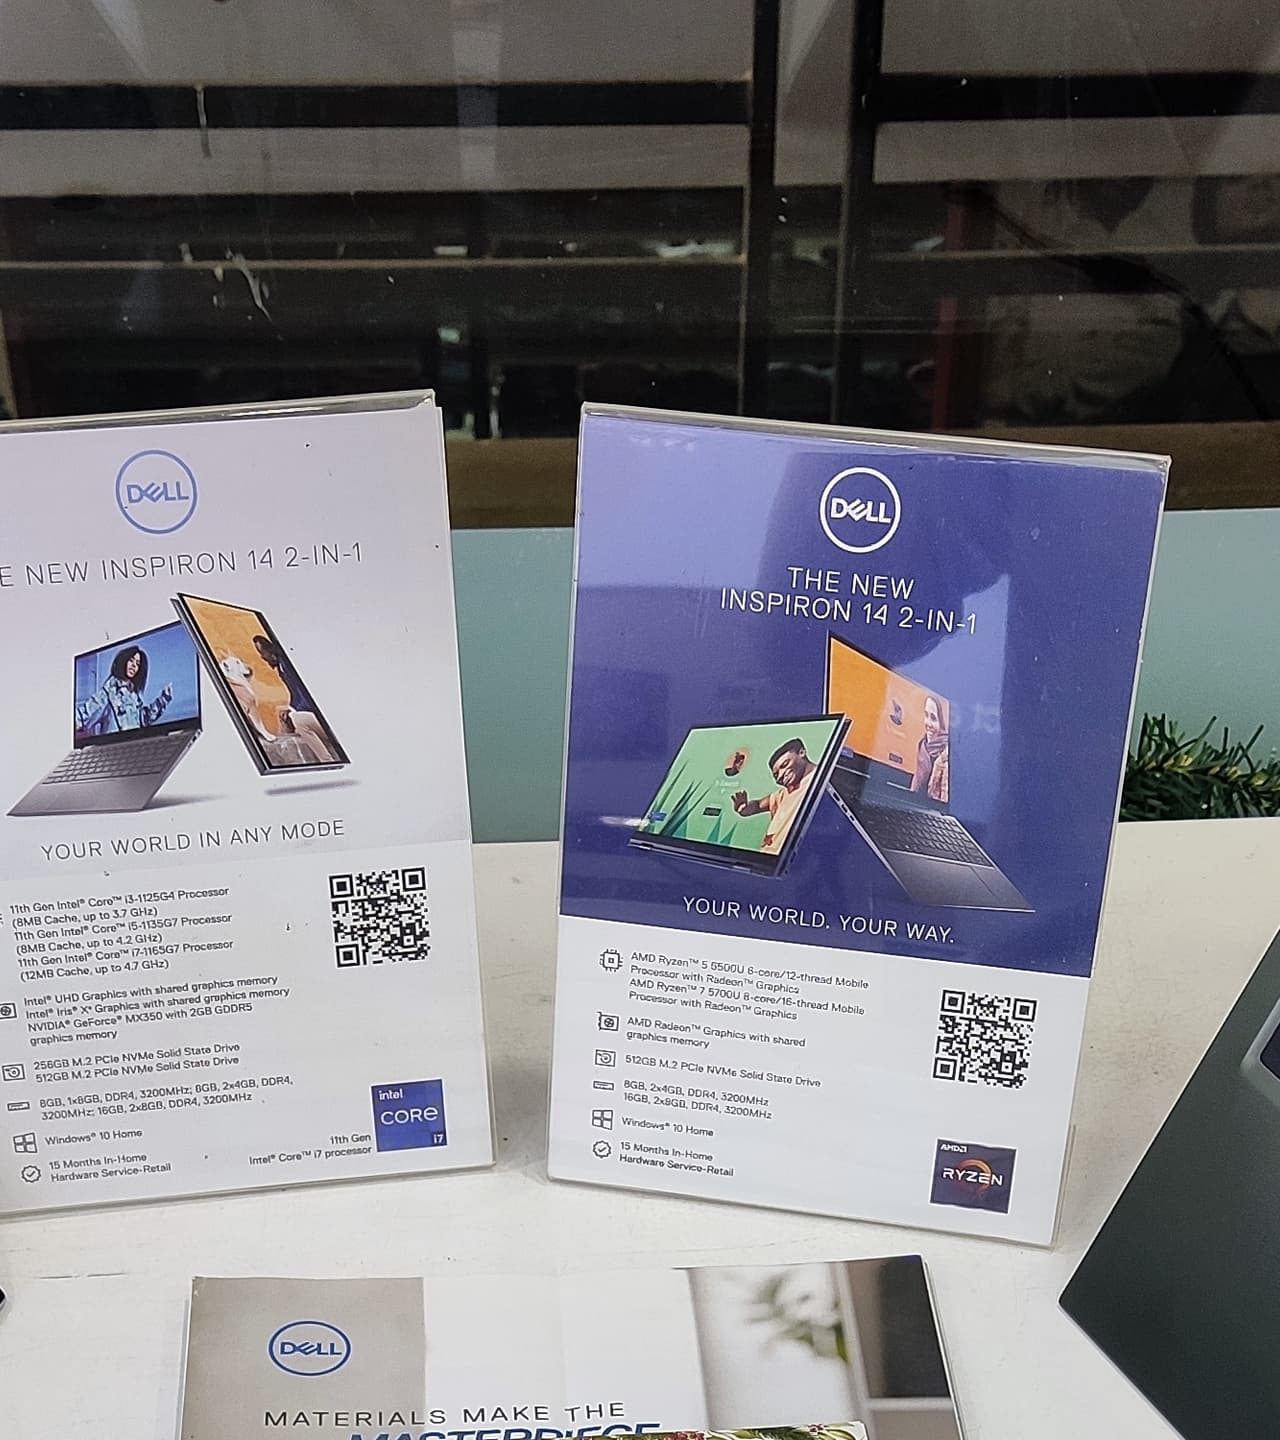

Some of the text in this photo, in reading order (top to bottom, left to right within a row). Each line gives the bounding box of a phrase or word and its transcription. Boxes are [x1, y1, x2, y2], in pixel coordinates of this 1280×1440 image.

[126, 480, 190, 504] DELL
[830, 496, 892, 524] DELL
[25, 559, 88, 585] NEW
[101, 550, 235, 580] INSPIRON
[247, 548, 272, 570] 14
[284, 541, 360, 567] 2-IN-1
[787, 566, 914, 599] THE NEW
[721, 586, 976, 635] INSPIRON 14 2-IN-1
[40, 819, 344, 860] YOUR WORLD IN ANY MODE
[683, 896, 953, 943] YOUR WORLD. YOUR WAY.
[54, 992, 79, 1003] UHD
[81, 989, 127, 1001] Graphics
[129, 986, 152, 997] with
[154, 982, 188, 994] shared
[191, 979, 234, 993] graphics
[236, 976, 277, 987] memory
[29, 1030, 117, 1047] graphics memory
[626, 1031, 709, 1049] graphics memory
[379, 1088, 404, 1101] intel
[99, 1129, 111, 1140] 10
[112, 1127, 142, 1139] Home
[329, 1133, 372, 1145] 11th Gen
[433, 1134, 445, 1144] i7
[48, 1153, 147, 1170] 15 Months In-Home
[620, 1141, 713, 1161] 15 Months In-Home
[47, 1162, 171, 1184] Hardware Service-Retail
[619, 1153, 733, 1176] Hardware Service-Retail
[942, 1167, 1004, 1186] RYZEN
[279, 1341, 342, 1357] DELL
[264, 1402, 624, 1426] MATERIALS MAKE THE
